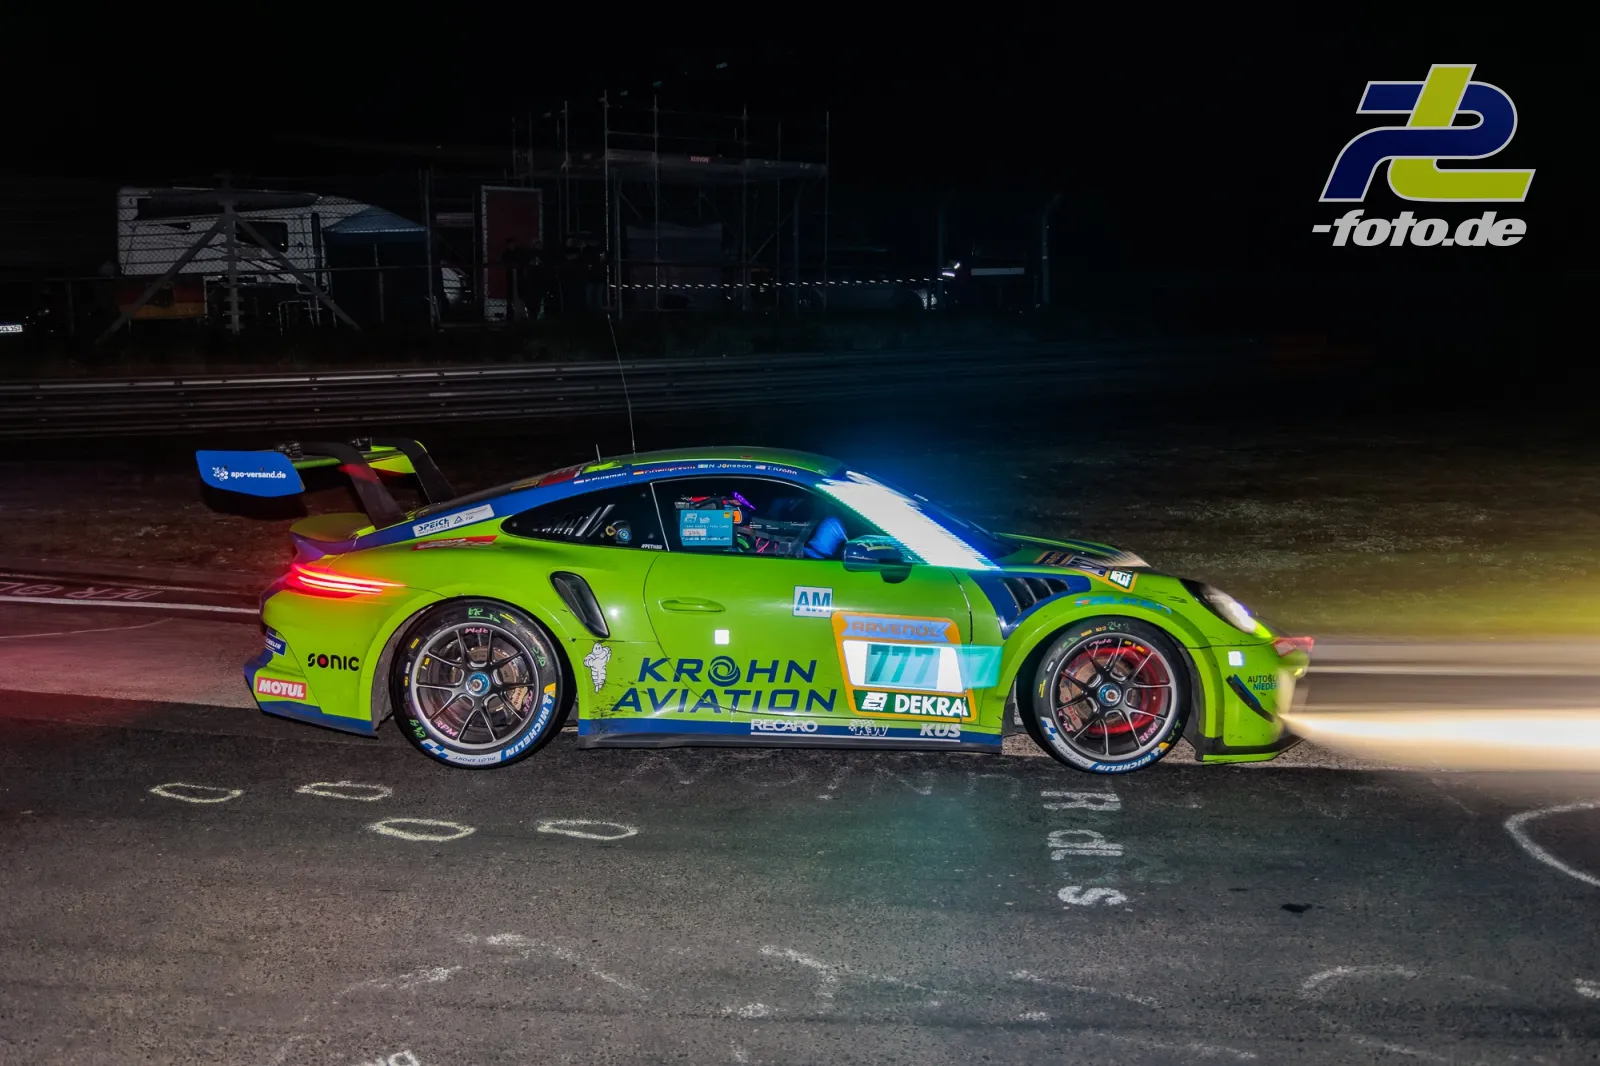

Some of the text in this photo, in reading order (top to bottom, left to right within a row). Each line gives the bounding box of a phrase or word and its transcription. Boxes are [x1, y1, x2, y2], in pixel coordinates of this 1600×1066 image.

[230, 471, 287, 479] apo-versand.de
[796, 591, 831, 612] AM
[637, 656, 818, 688] KROHN
[869, 646, 935, 684] 777
[258, 680, 305, 698] MOTUL
[610, 687, 838, 714] AVIATION
[894, 694, 969, 717] DEKRA
[434, 720, 460, 737] RPM
[505, 706, 550, 758] MICHELIN
[750, 718, 818, 733] RECARO
[1095, 755, 1152, 772] MICHELIN
